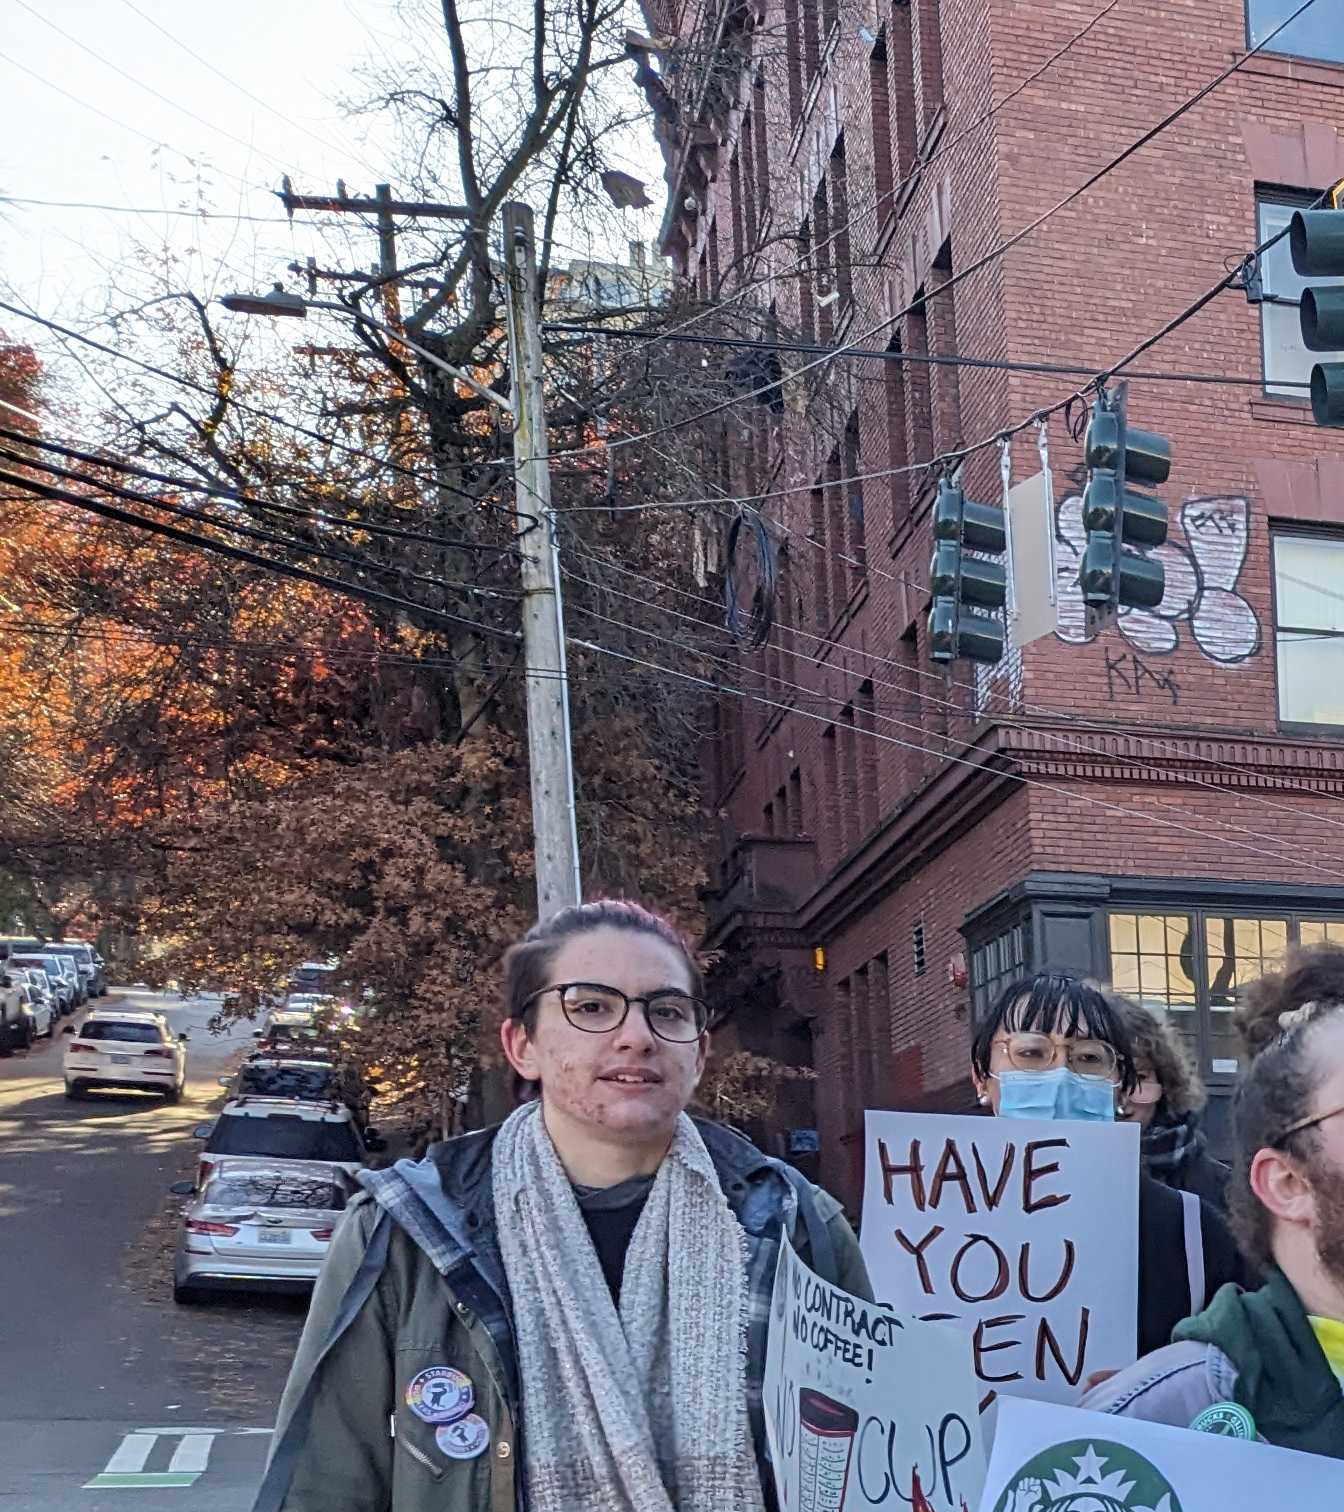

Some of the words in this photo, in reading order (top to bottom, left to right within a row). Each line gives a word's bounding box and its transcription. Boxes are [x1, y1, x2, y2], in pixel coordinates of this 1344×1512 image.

[878, 1137, 1072, 1214] HAVE
[894, 1225, 1075, 1303] YOU
[792, 1305, 808, 1343] NO
[810, 1321, 874, 1384] COFFEE!
[804, 1276, 905, 1347] CONTRACT
[857, 1413, 972, 1506] CUP
